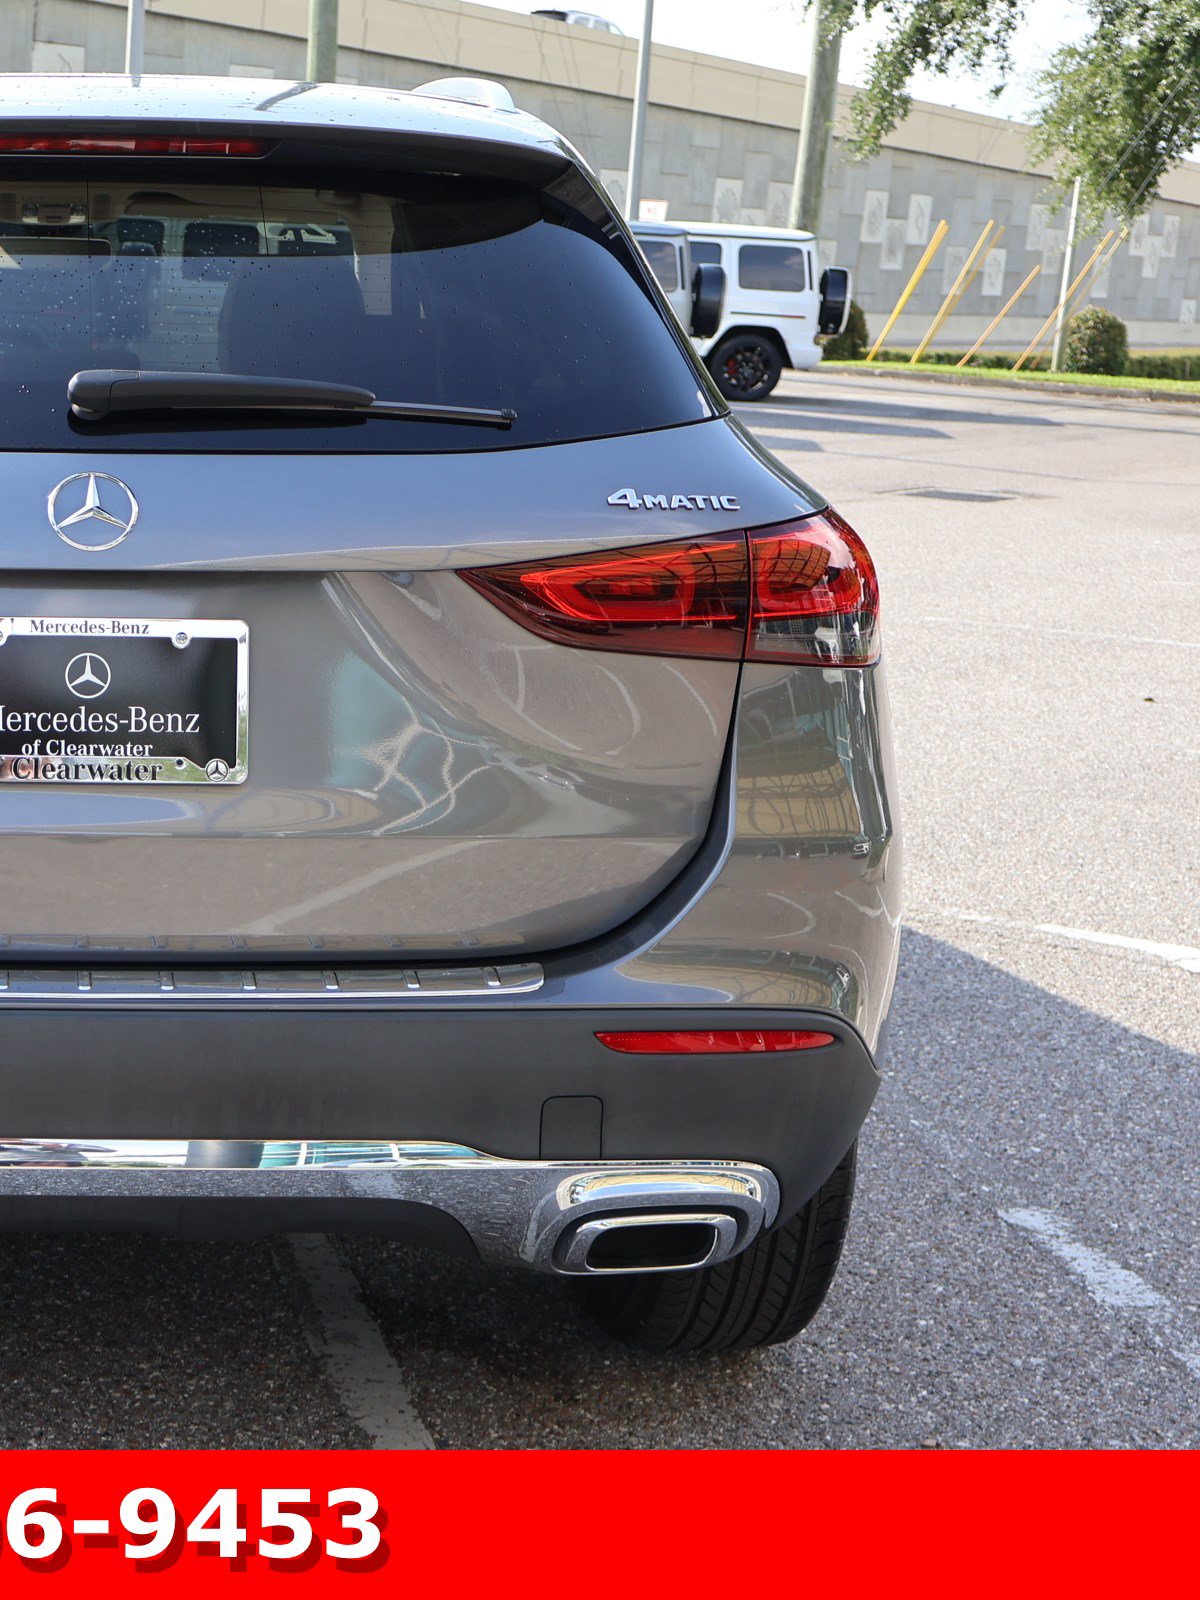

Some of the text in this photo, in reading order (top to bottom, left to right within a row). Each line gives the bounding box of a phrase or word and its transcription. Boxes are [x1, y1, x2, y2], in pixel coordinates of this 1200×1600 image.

[607, 488, 741, 511] 4MATIC
[29, 619, 150, 636] Mercedes-Benz
[21, 739, 154, 757] of Clearwater
[11, 756, 164, 782] Clearwater
